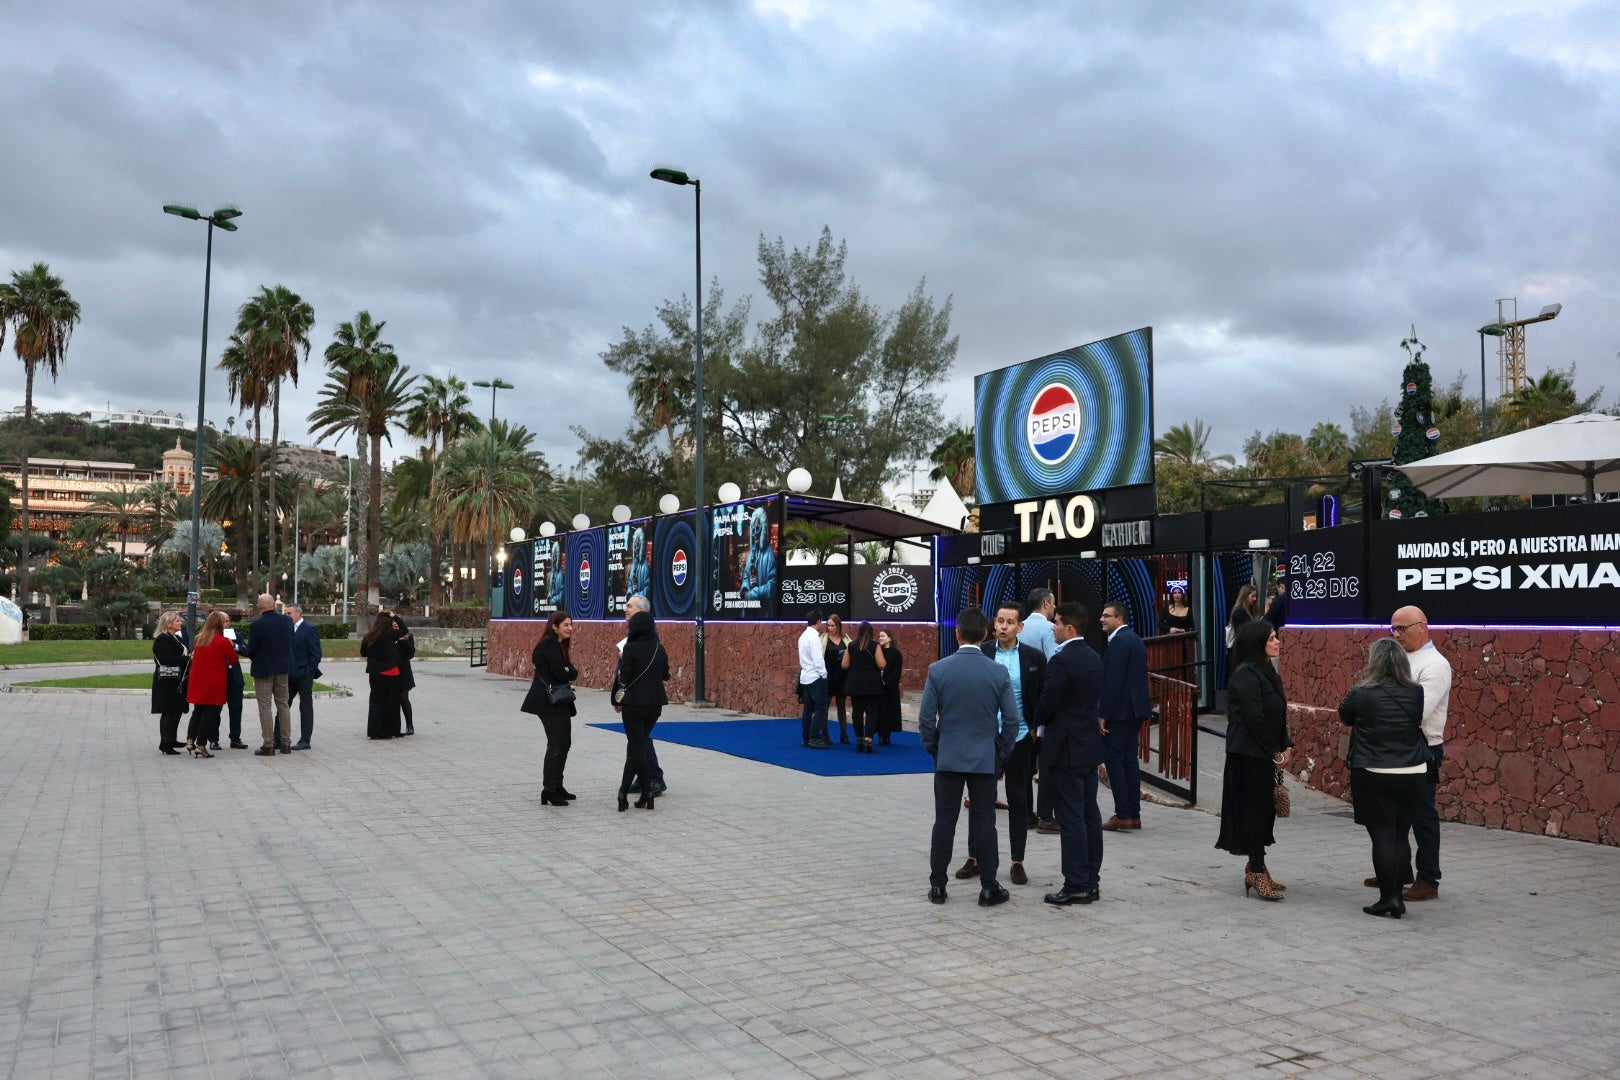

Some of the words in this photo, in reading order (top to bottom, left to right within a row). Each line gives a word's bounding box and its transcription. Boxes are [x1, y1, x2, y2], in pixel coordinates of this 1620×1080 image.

[1032, 413, 1076, 435] PEPSI
[48, 479, 82, 489] SANTA
[1013, 495, 1095, 543] TAO
[1397, 542, 1450, 559] NAVIDAD
[1452, 538, 1468, 559] SÍ,
[1471, 539, 1505, 556] PERO
[1508, 538, 1518, 555] A
[1521, 535, 1588, 554] NUESTRA
[673, 563, 687, 572] PEPSI
[887, 567, 904, 575] 2023
[1290, 554, 1310, 577] 21,
[1313, 551, 1335, 573] 22
[1397, 565, 1512, 591] PEPSI
[1519, 562, 1620, 589] XMA
[781, 579, 802, 592] 21,
[804, 579, 825, 590] 22
[881, 586, 909, 594] PEPSI
[1291, 580, 1303, 599] &
[1305, 579, 1328, 598] 23
[1329, 576, 1359, 598] DIC
[782, 592, 795, 604] &
[796, 592, 817, 603] 23
[819, 592, 846, 603] DIC
